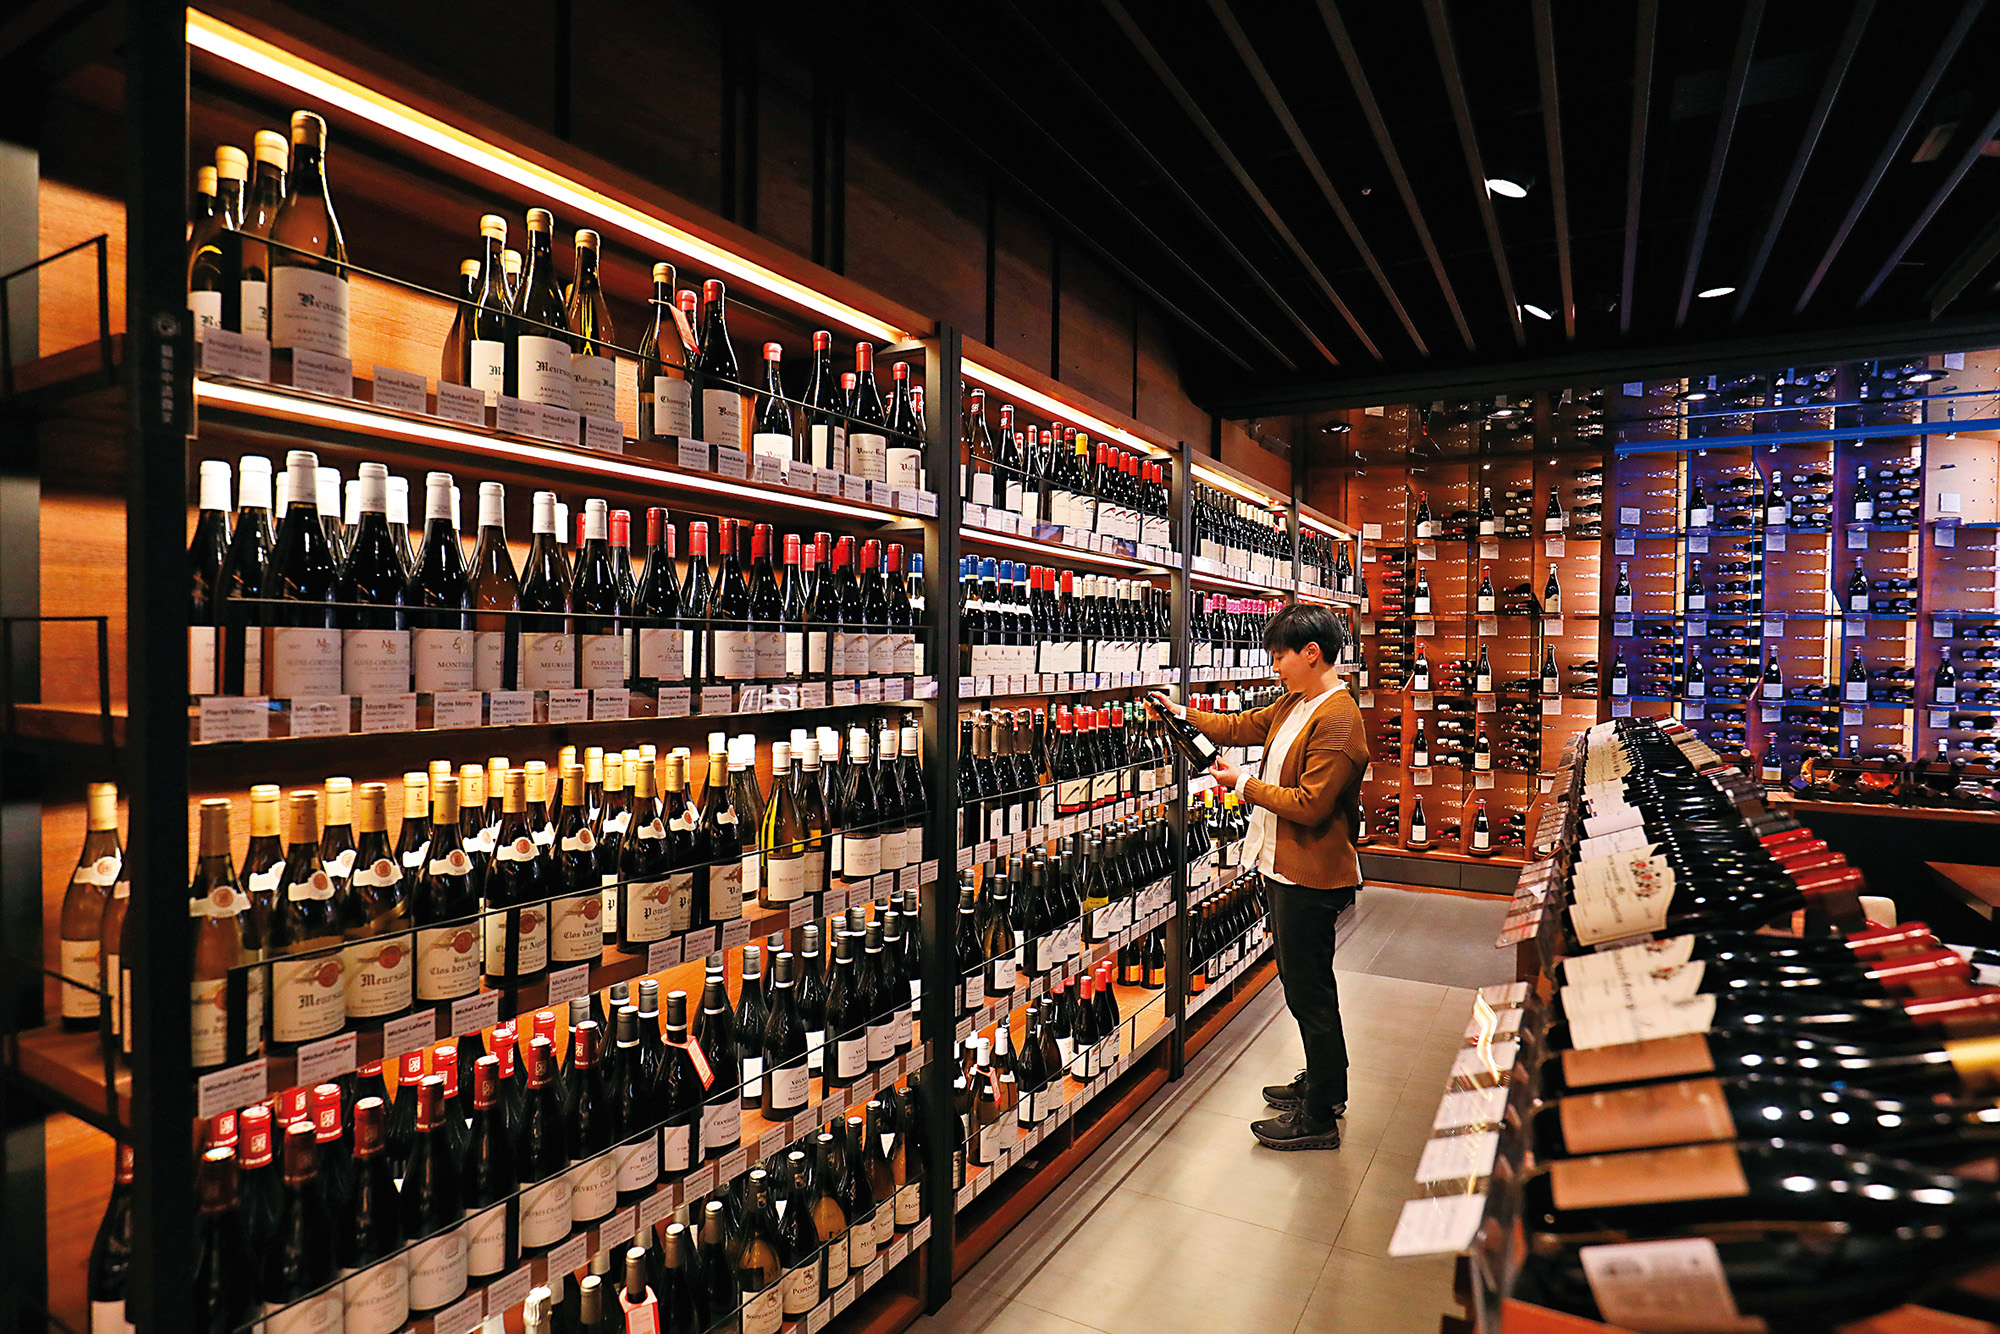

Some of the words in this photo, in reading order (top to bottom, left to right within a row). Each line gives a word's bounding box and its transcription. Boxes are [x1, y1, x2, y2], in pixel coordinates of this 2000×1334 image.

[365, 703, 386, 711] Morey
[430, 964, 449, 977] Clos
[451, 962, 465, 974] des
[552, 978, 567, 986] Michel
[567, 974, 586, 983] Lafarge
[454, 1005, 474, 1015] Michel
[475, 1000, 494, 1011] Lafarge
[388, 1026, 408, 1036] Michel
[409, 1020, 431, 1030] Lafarge
